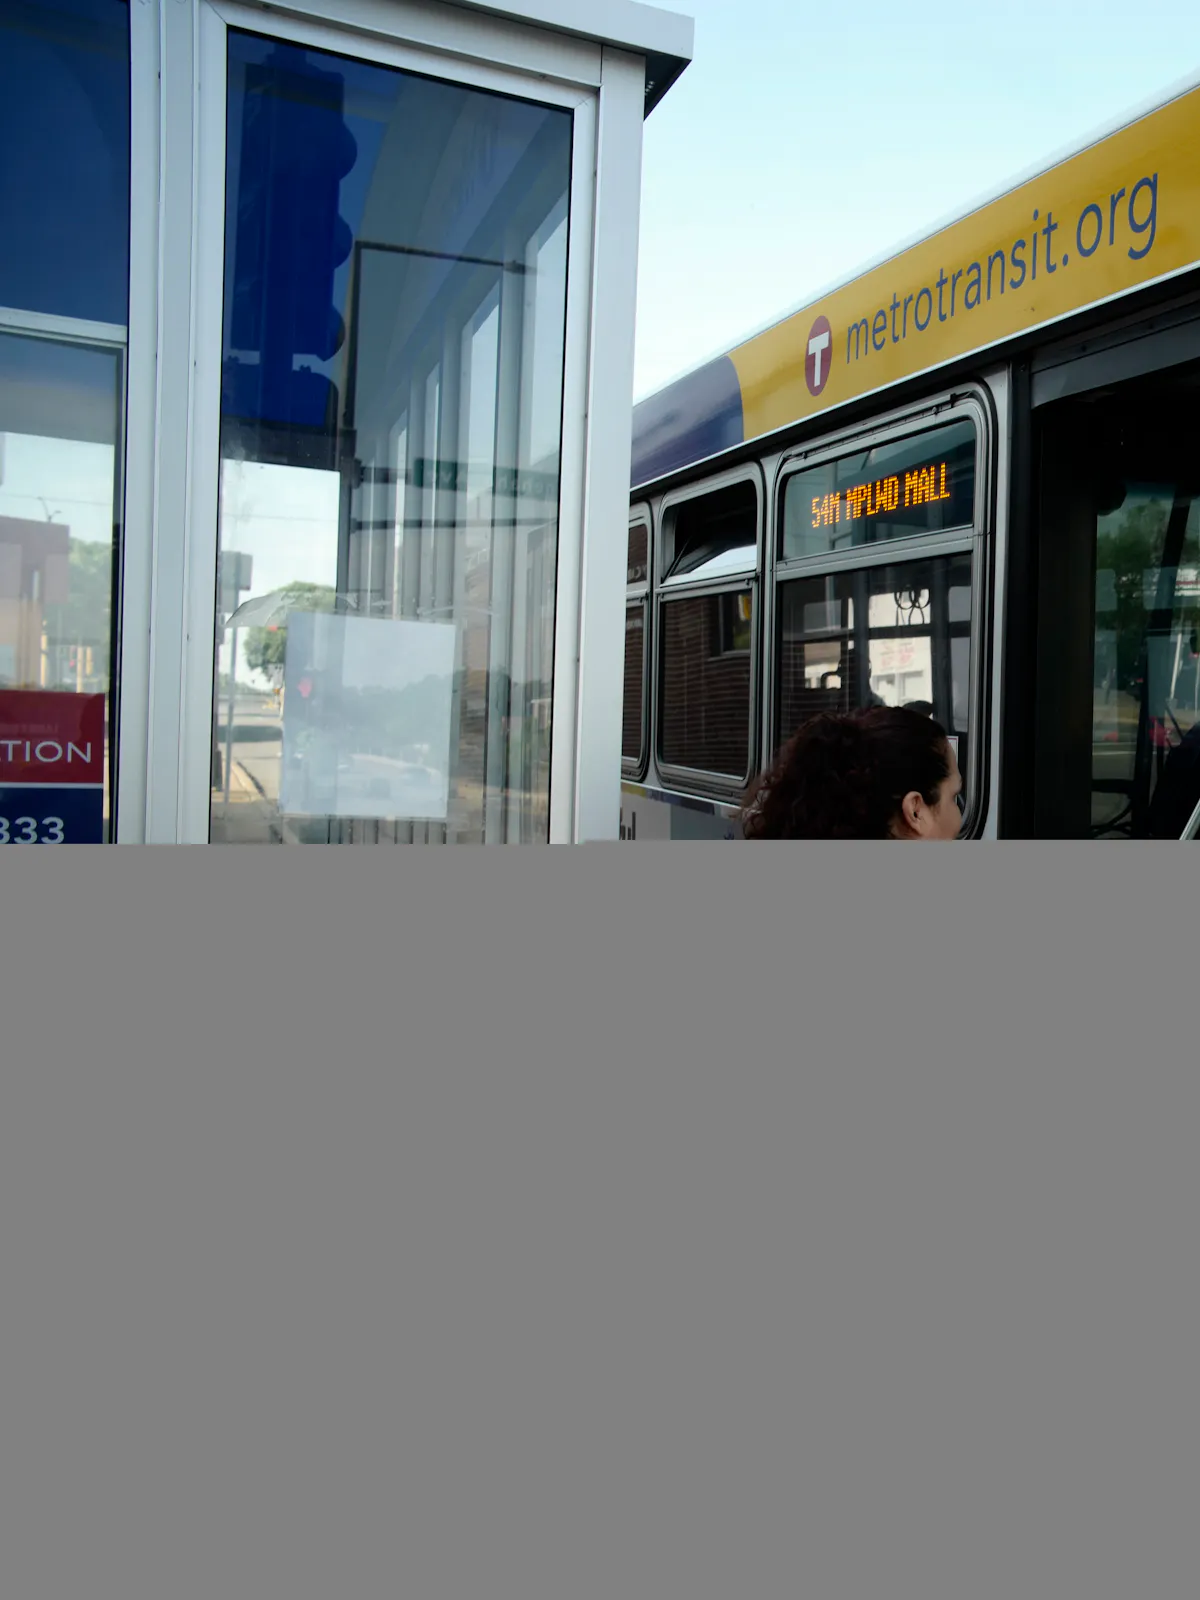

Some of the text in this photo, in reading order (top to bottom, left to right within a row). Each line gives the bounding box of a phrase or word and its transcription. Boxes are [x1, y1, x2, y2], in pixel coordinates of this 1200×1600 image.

[808, 172, 1159, 387] T metrotransit.org
[811, 462, 951, 528] 54M MPLWD MALL
[0, 740, 91, 763] TION
